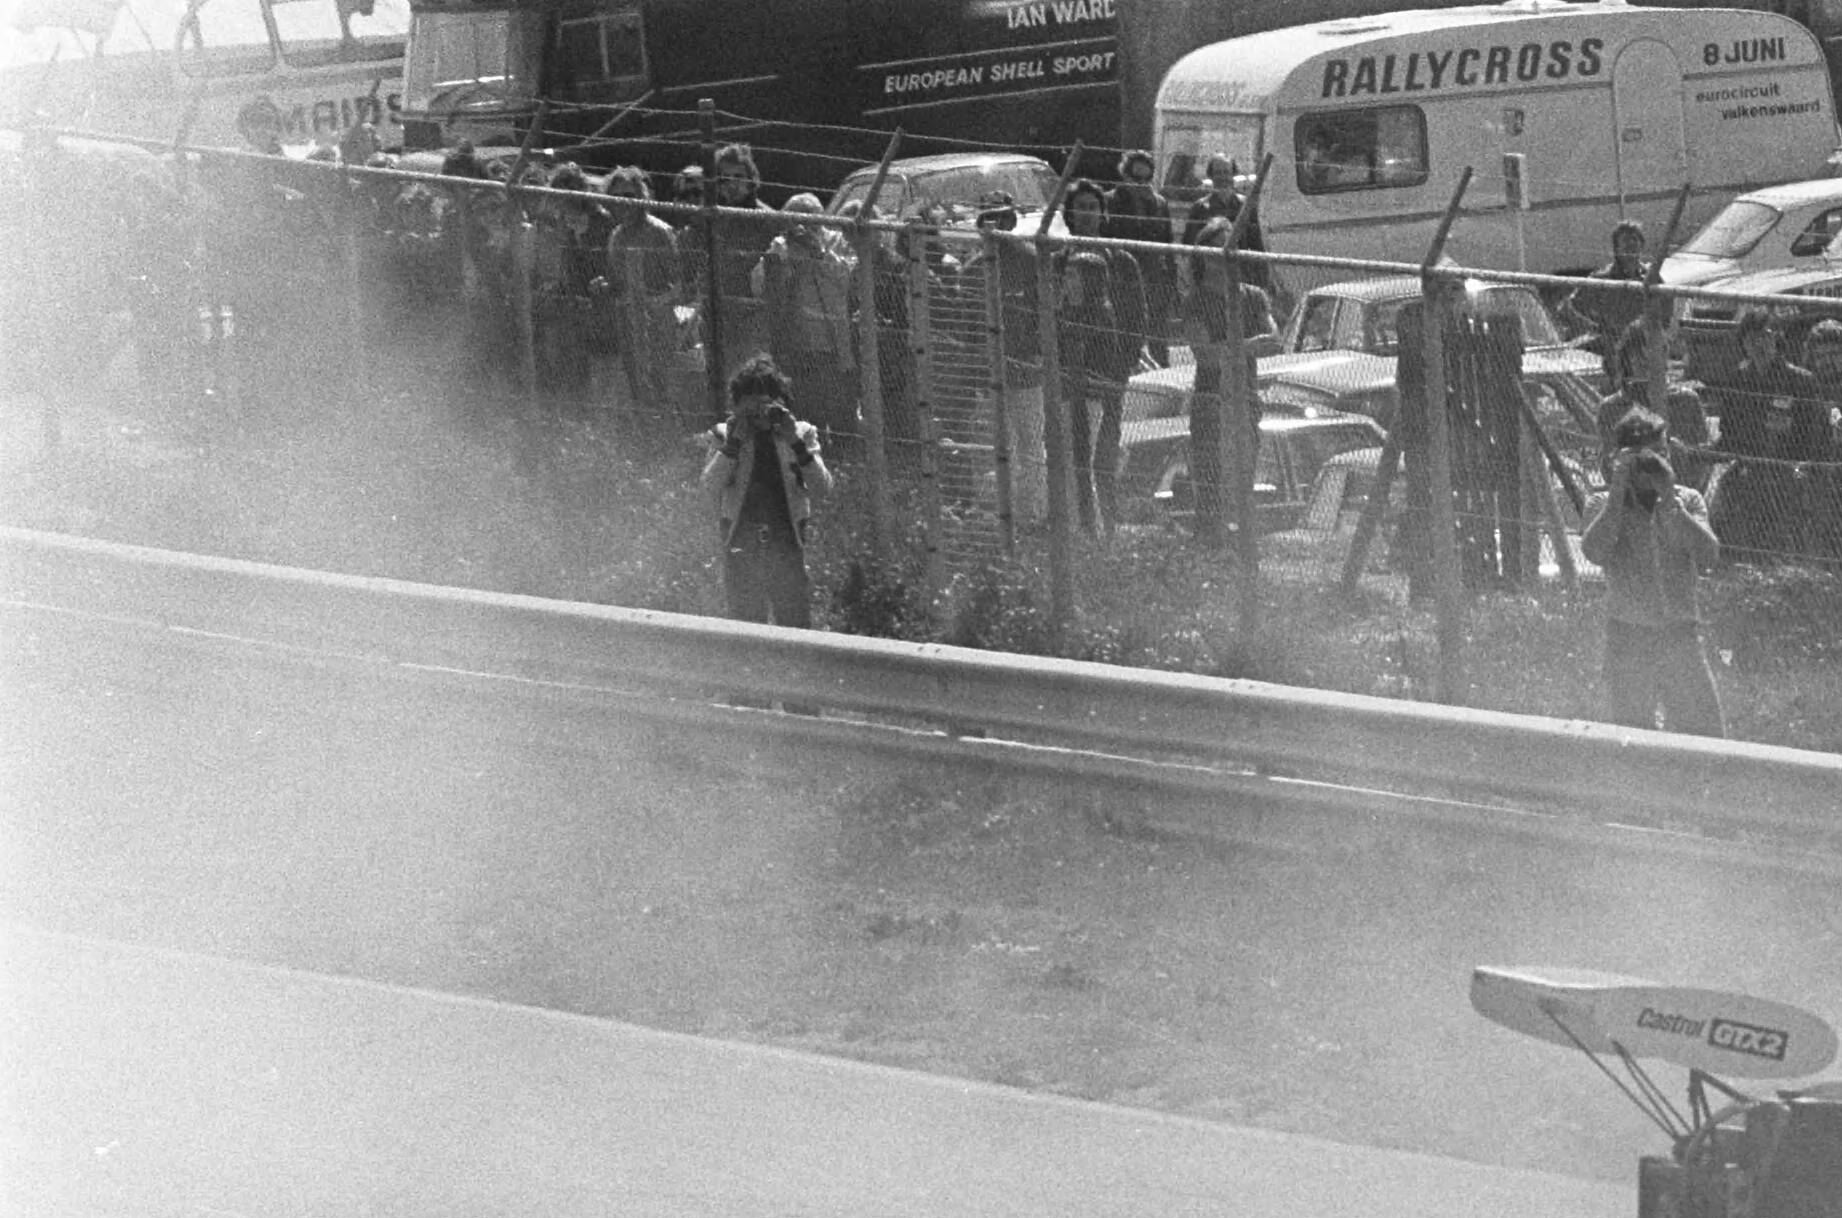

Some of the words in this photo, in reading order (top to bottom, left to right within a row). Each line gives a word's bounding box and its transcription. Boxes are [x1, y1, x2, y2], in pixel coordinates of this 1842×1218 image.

[1006, 4, 1047, 29] IAN
[1321, 38, 1604, 98] RALLYCROSS
[1703, 43, 1719, 66] 8
[1724, 36, 1786, 64] JUNI
[884, 66, 983, 93] EUROPEAN
[990, 60, 1045, 82] SHELL
[1052, 52, 1115, 75] SPORT
[1695, 81, 1781, 103] eurocircuit
[1636, 1007, 1707, 1038] Castrol
[1710, 1020, 1786, 1058] GTX2
